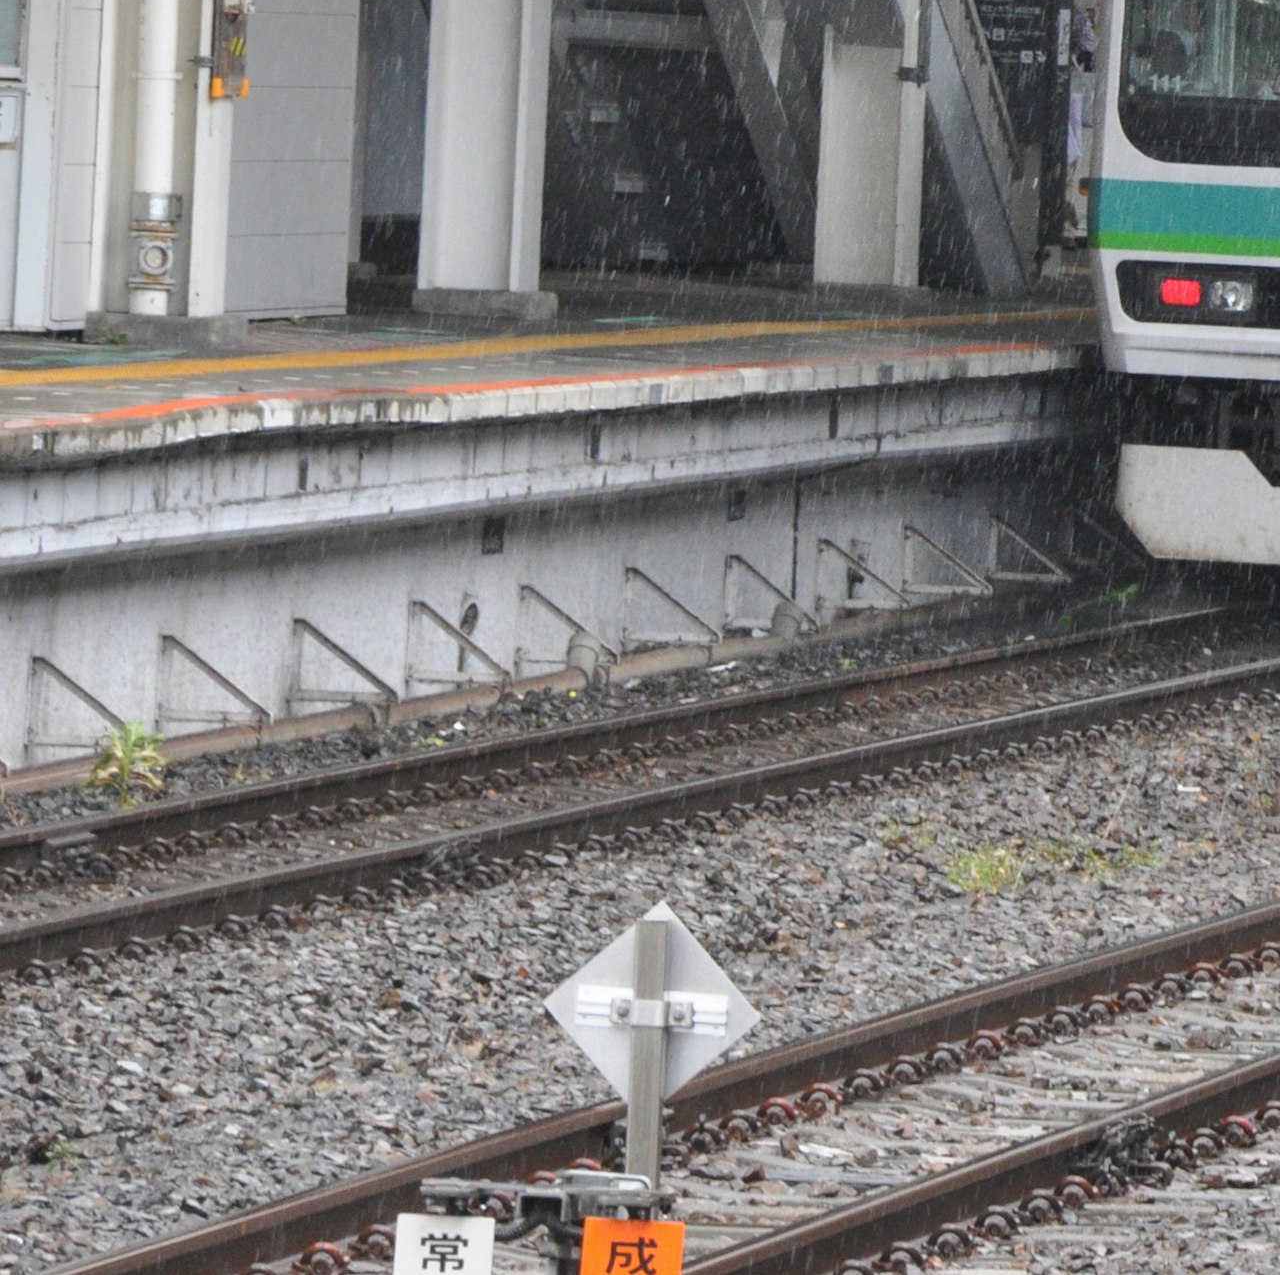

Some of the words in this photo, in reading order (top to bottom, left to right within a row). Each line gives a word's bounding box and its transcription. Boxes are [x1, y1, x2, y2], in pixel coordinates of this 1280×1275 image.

[1149, 75, 1181, 92] 111
[420, 1232, 469, 1273] 常
[605, 1236, 658, 1275] 成
